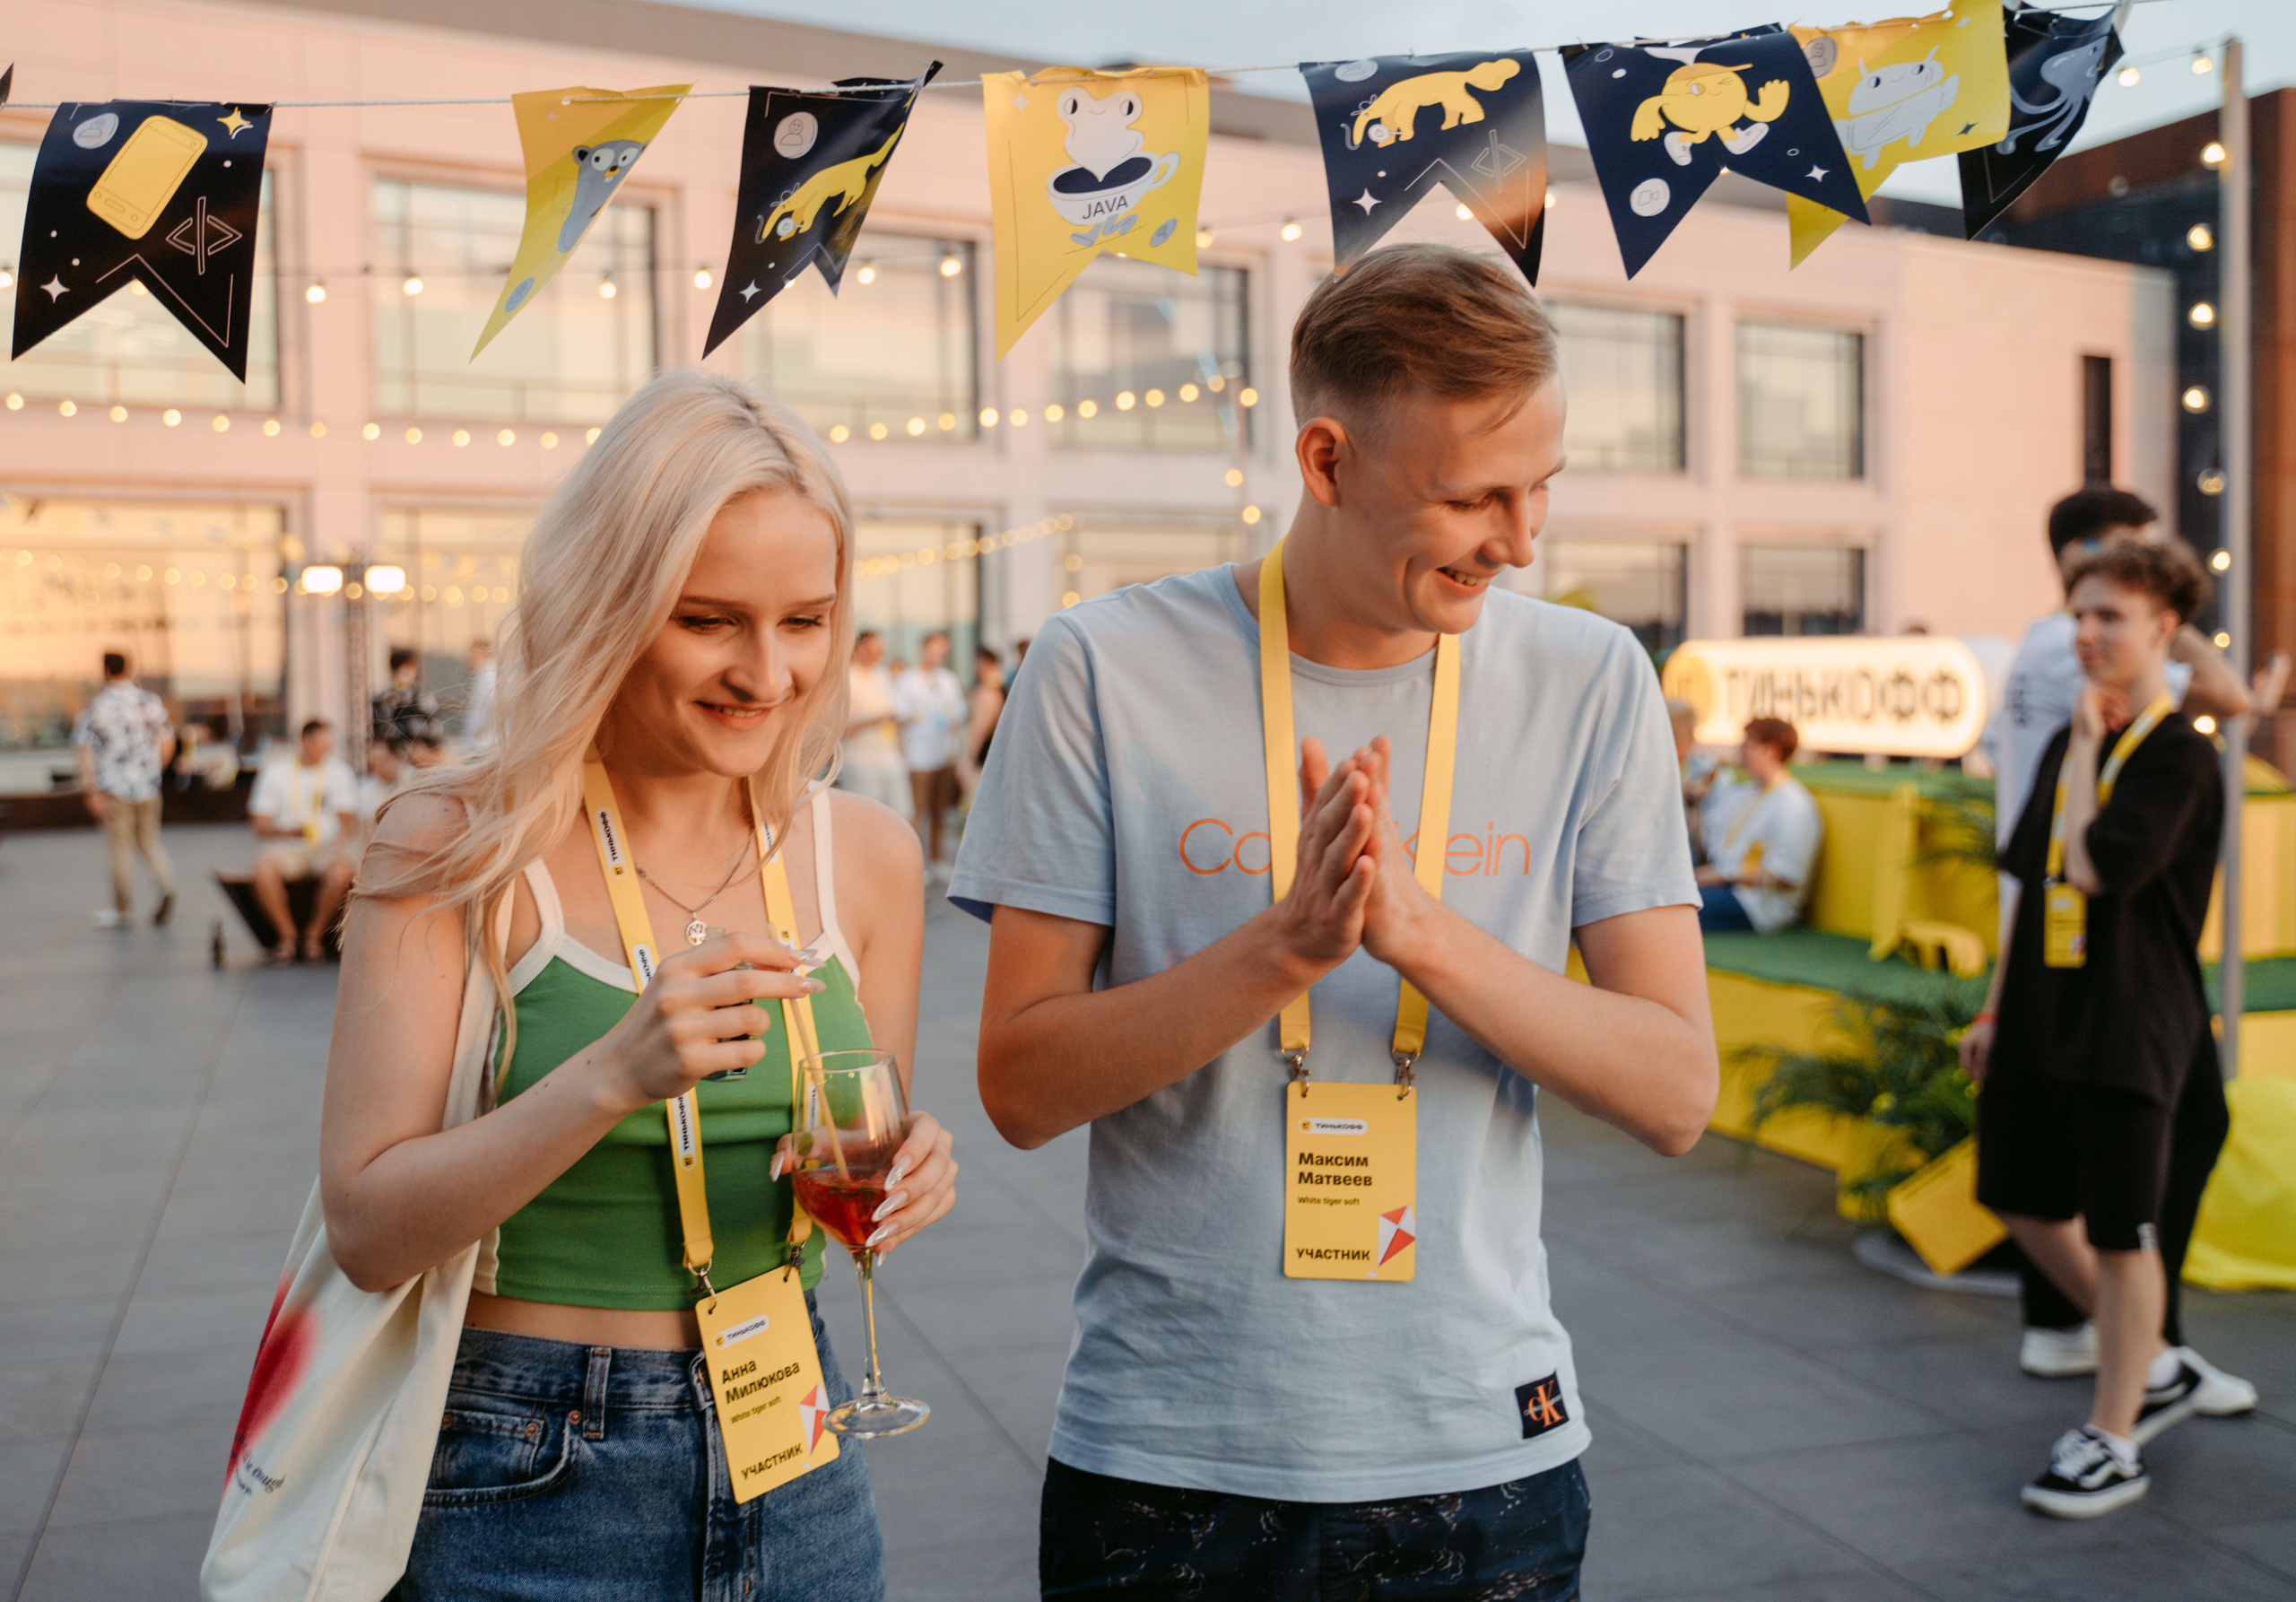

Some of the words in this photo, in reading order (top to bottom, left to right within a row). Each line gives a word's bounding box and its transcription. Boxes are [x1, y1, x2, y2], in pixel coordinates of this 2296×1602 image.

[1083, 195, 1128, 220] JAVA
[1726, 669, 1961, 723] ТИНЬКОФФ
[600, 811, 618, 861] ТИНЬКОФФ
[1315, 1122, 1364, 1130] ТИНЬКОФФ
[1298, 1153, 1369, 1167] Максим
[1298, 1171, 1373, 1186] Матвеев
[1298, 1196, 1321, 1205] White
[1323, 1197, 1342, 1206] tiger
[1344, 1197, 1360, 1206] soft
[1296, 1248, 1370, 1261] УЧАСТНИК
[726, 1319, 766, 1340] ТИНЬКОФФ
[721, 1360, 757, 1385] Анна
[725, 1362, 800, 1404] Милюкова
[730, 1410, 751, 1424] White
[752, 1402, 767, 1415] tiger
[768, 1396, 782, 1407] soft
[741, 1442, 803, 1480] УЧАСТНИК
